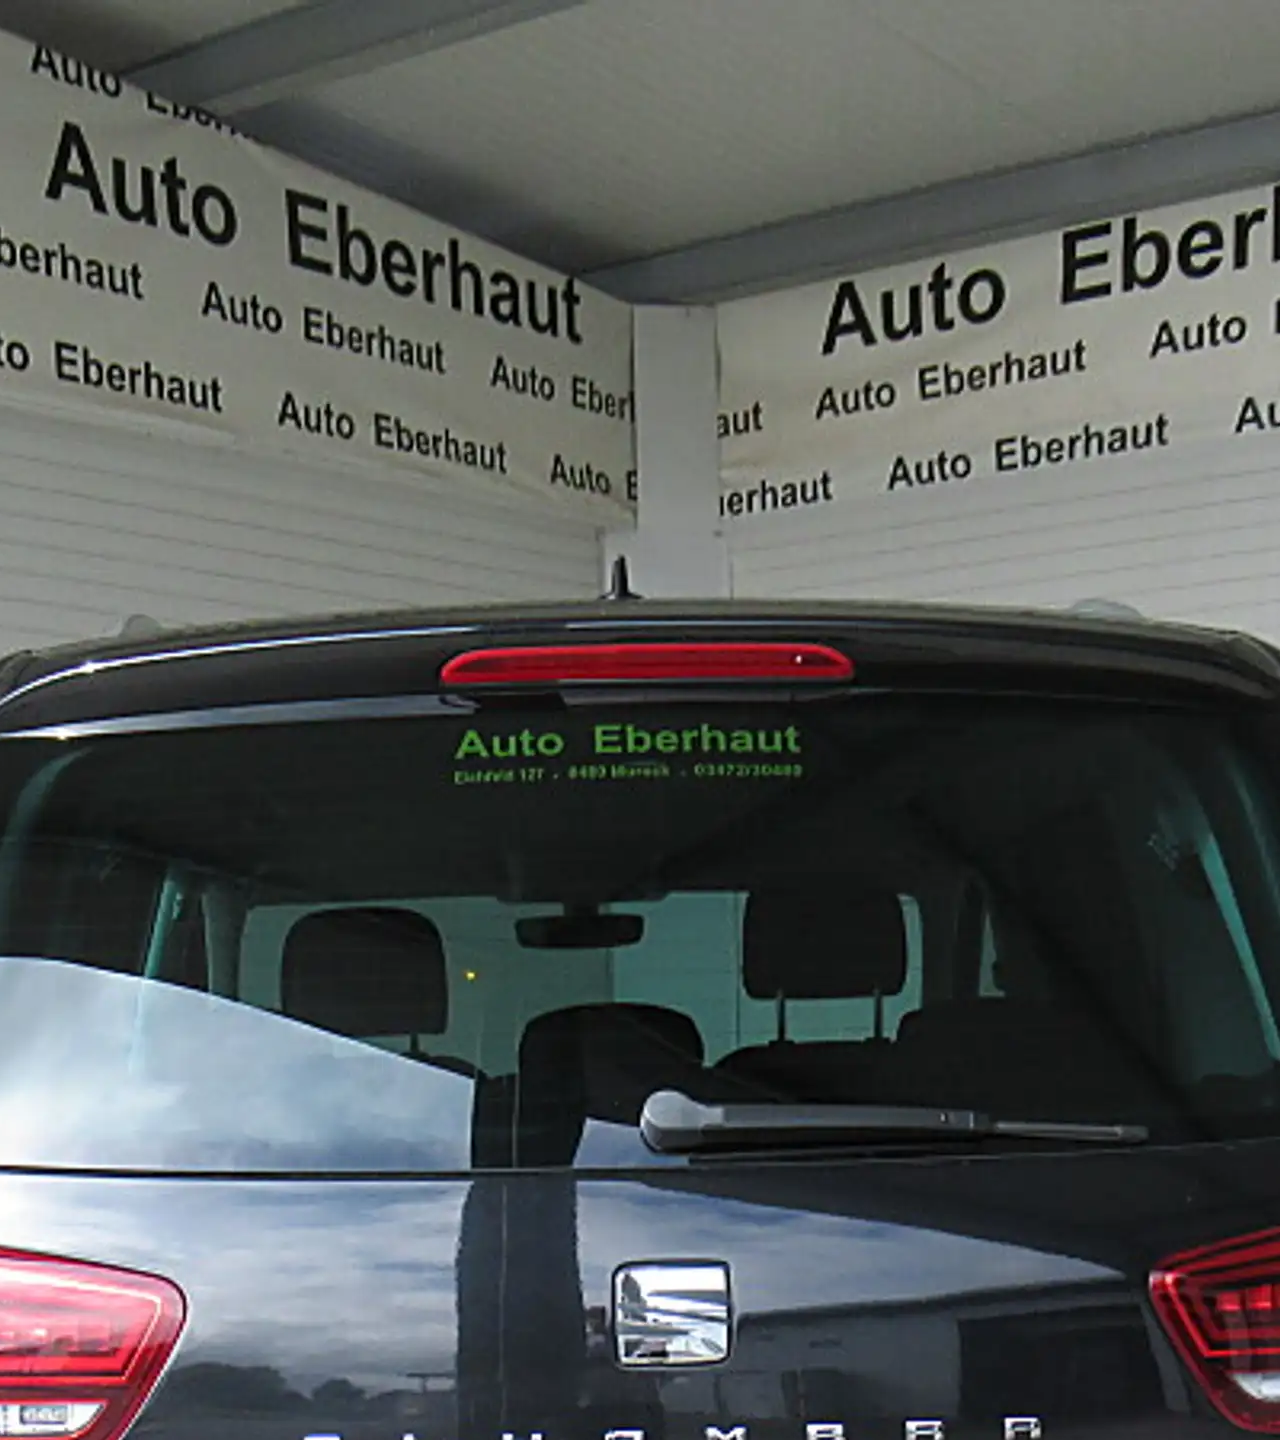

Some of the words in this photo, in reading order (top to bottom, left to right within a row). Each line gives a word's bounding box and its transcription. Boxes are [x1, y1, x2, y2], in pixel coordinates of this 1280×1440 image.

[44, 120, 238, 247] Auto
[284, 187, 583, 345] Eberhaut
[201, 281, 283, 335] Auto
[303, 306, 447, 376] Eberhaut
[821, 261, 1006, 356] Auto
[1150, 312, 1247, 358] Auto
[54, 343, 223, 414] Eberhaut
[489, 355, 556, 402] Auto
[815, 378, 896, 421] Auto
[918, 339, 1087, 401] Eberhaut
[277, 391, 355, 442] Auto
[373, 413, 508, 475] Eberhaut
[887, 450, 972, 491] Auto
[994, 413, 1169, 473] Eberhaut
[550, 453, 612, 497] Auto
[454, 729, 564, 760] Auto
[594, 723, 802, 755] Eberhaut
